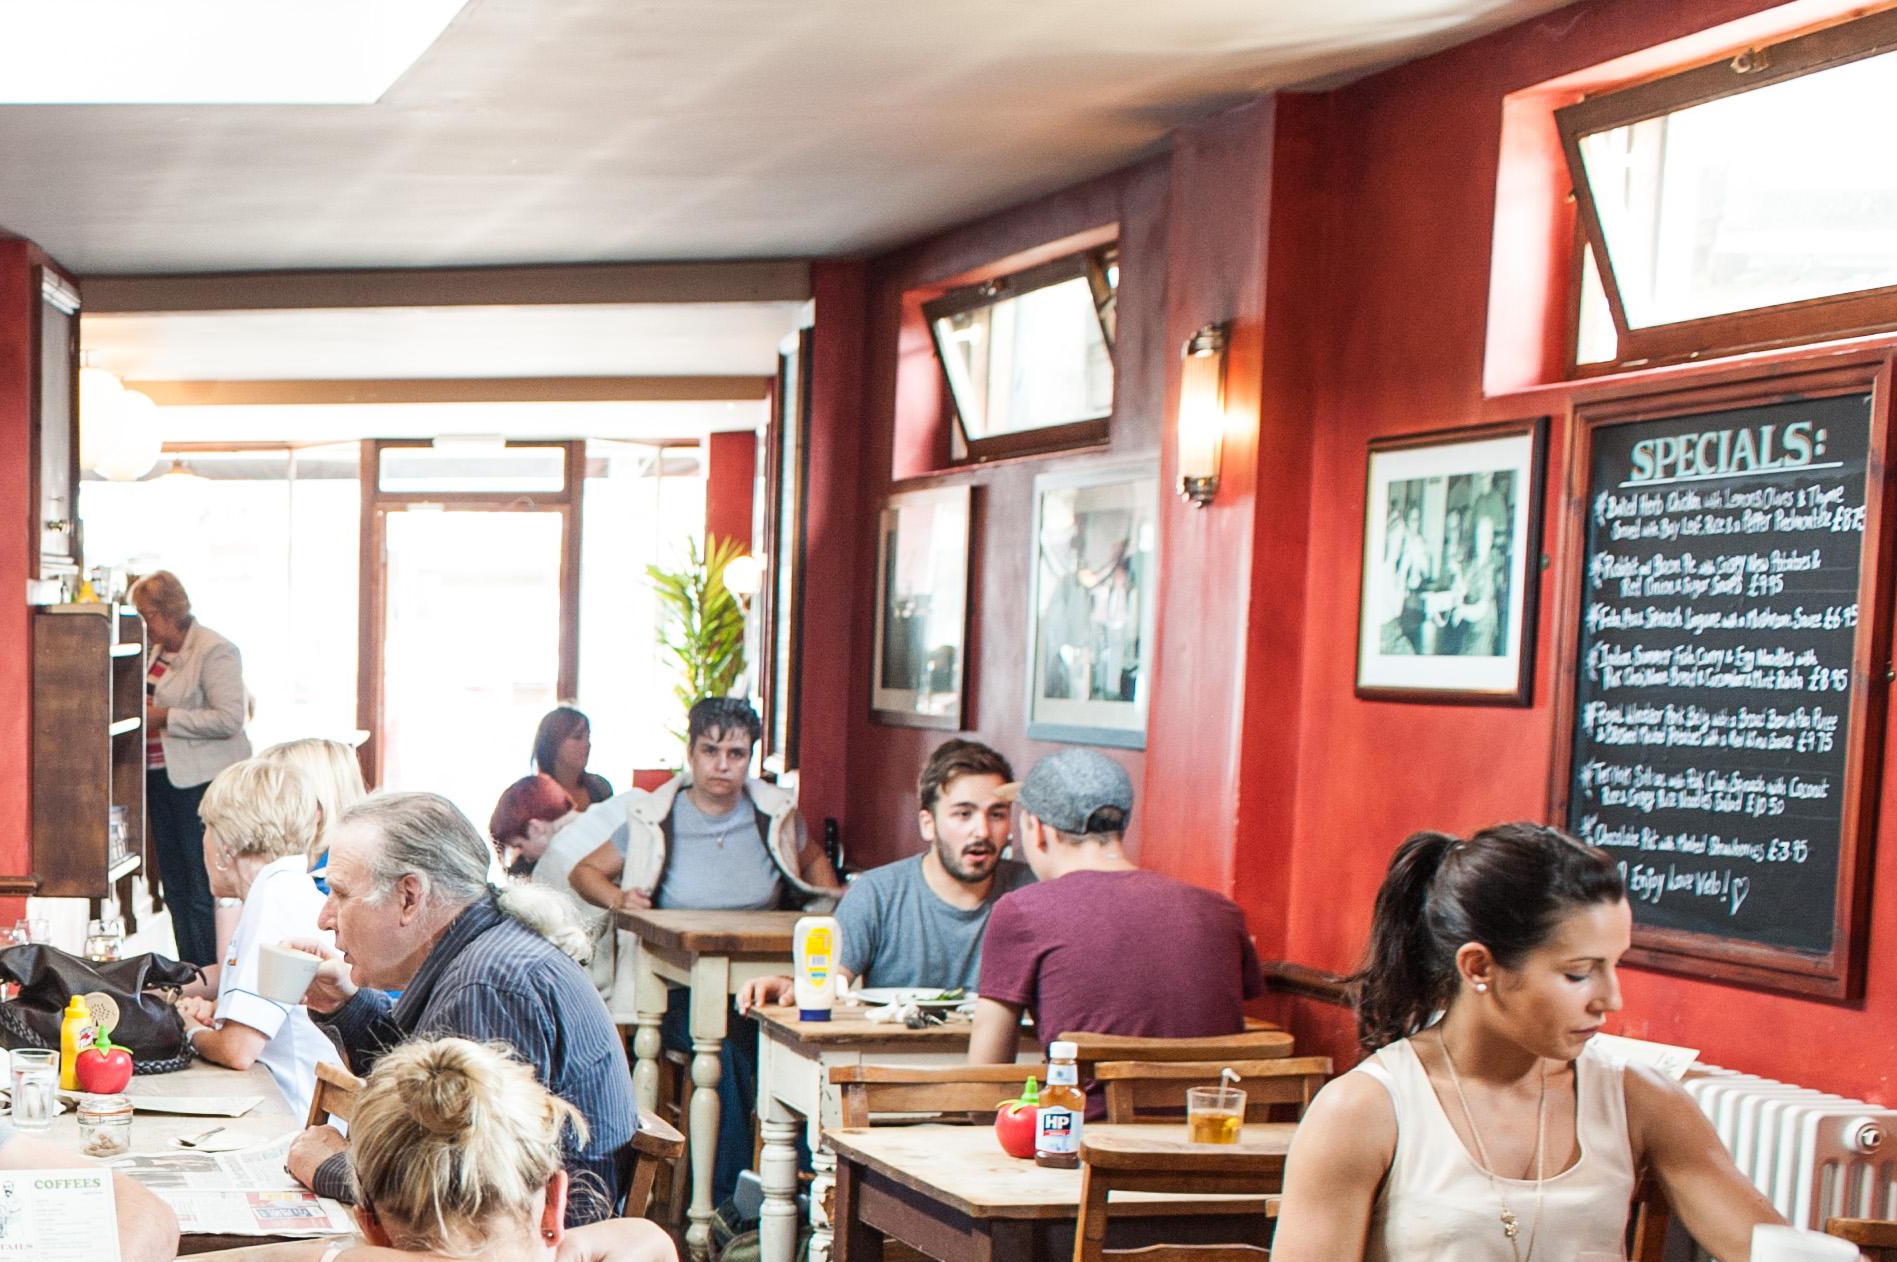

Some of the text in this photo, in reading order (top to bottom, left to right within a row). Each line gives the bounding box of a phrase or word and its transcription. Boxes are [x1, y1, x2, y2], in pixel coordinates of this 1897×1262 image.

[1631, 421, 1828, 481] SPECIALS:
[1665, 488, 1702, 513] Chicken
[1630, 864, 1665, 904] Enjoy
[1666, 863, 1694, 891] Love
[1045, 1115, 1070, 1130] HP
[34, 1178, 101, 1190] COFFEES
